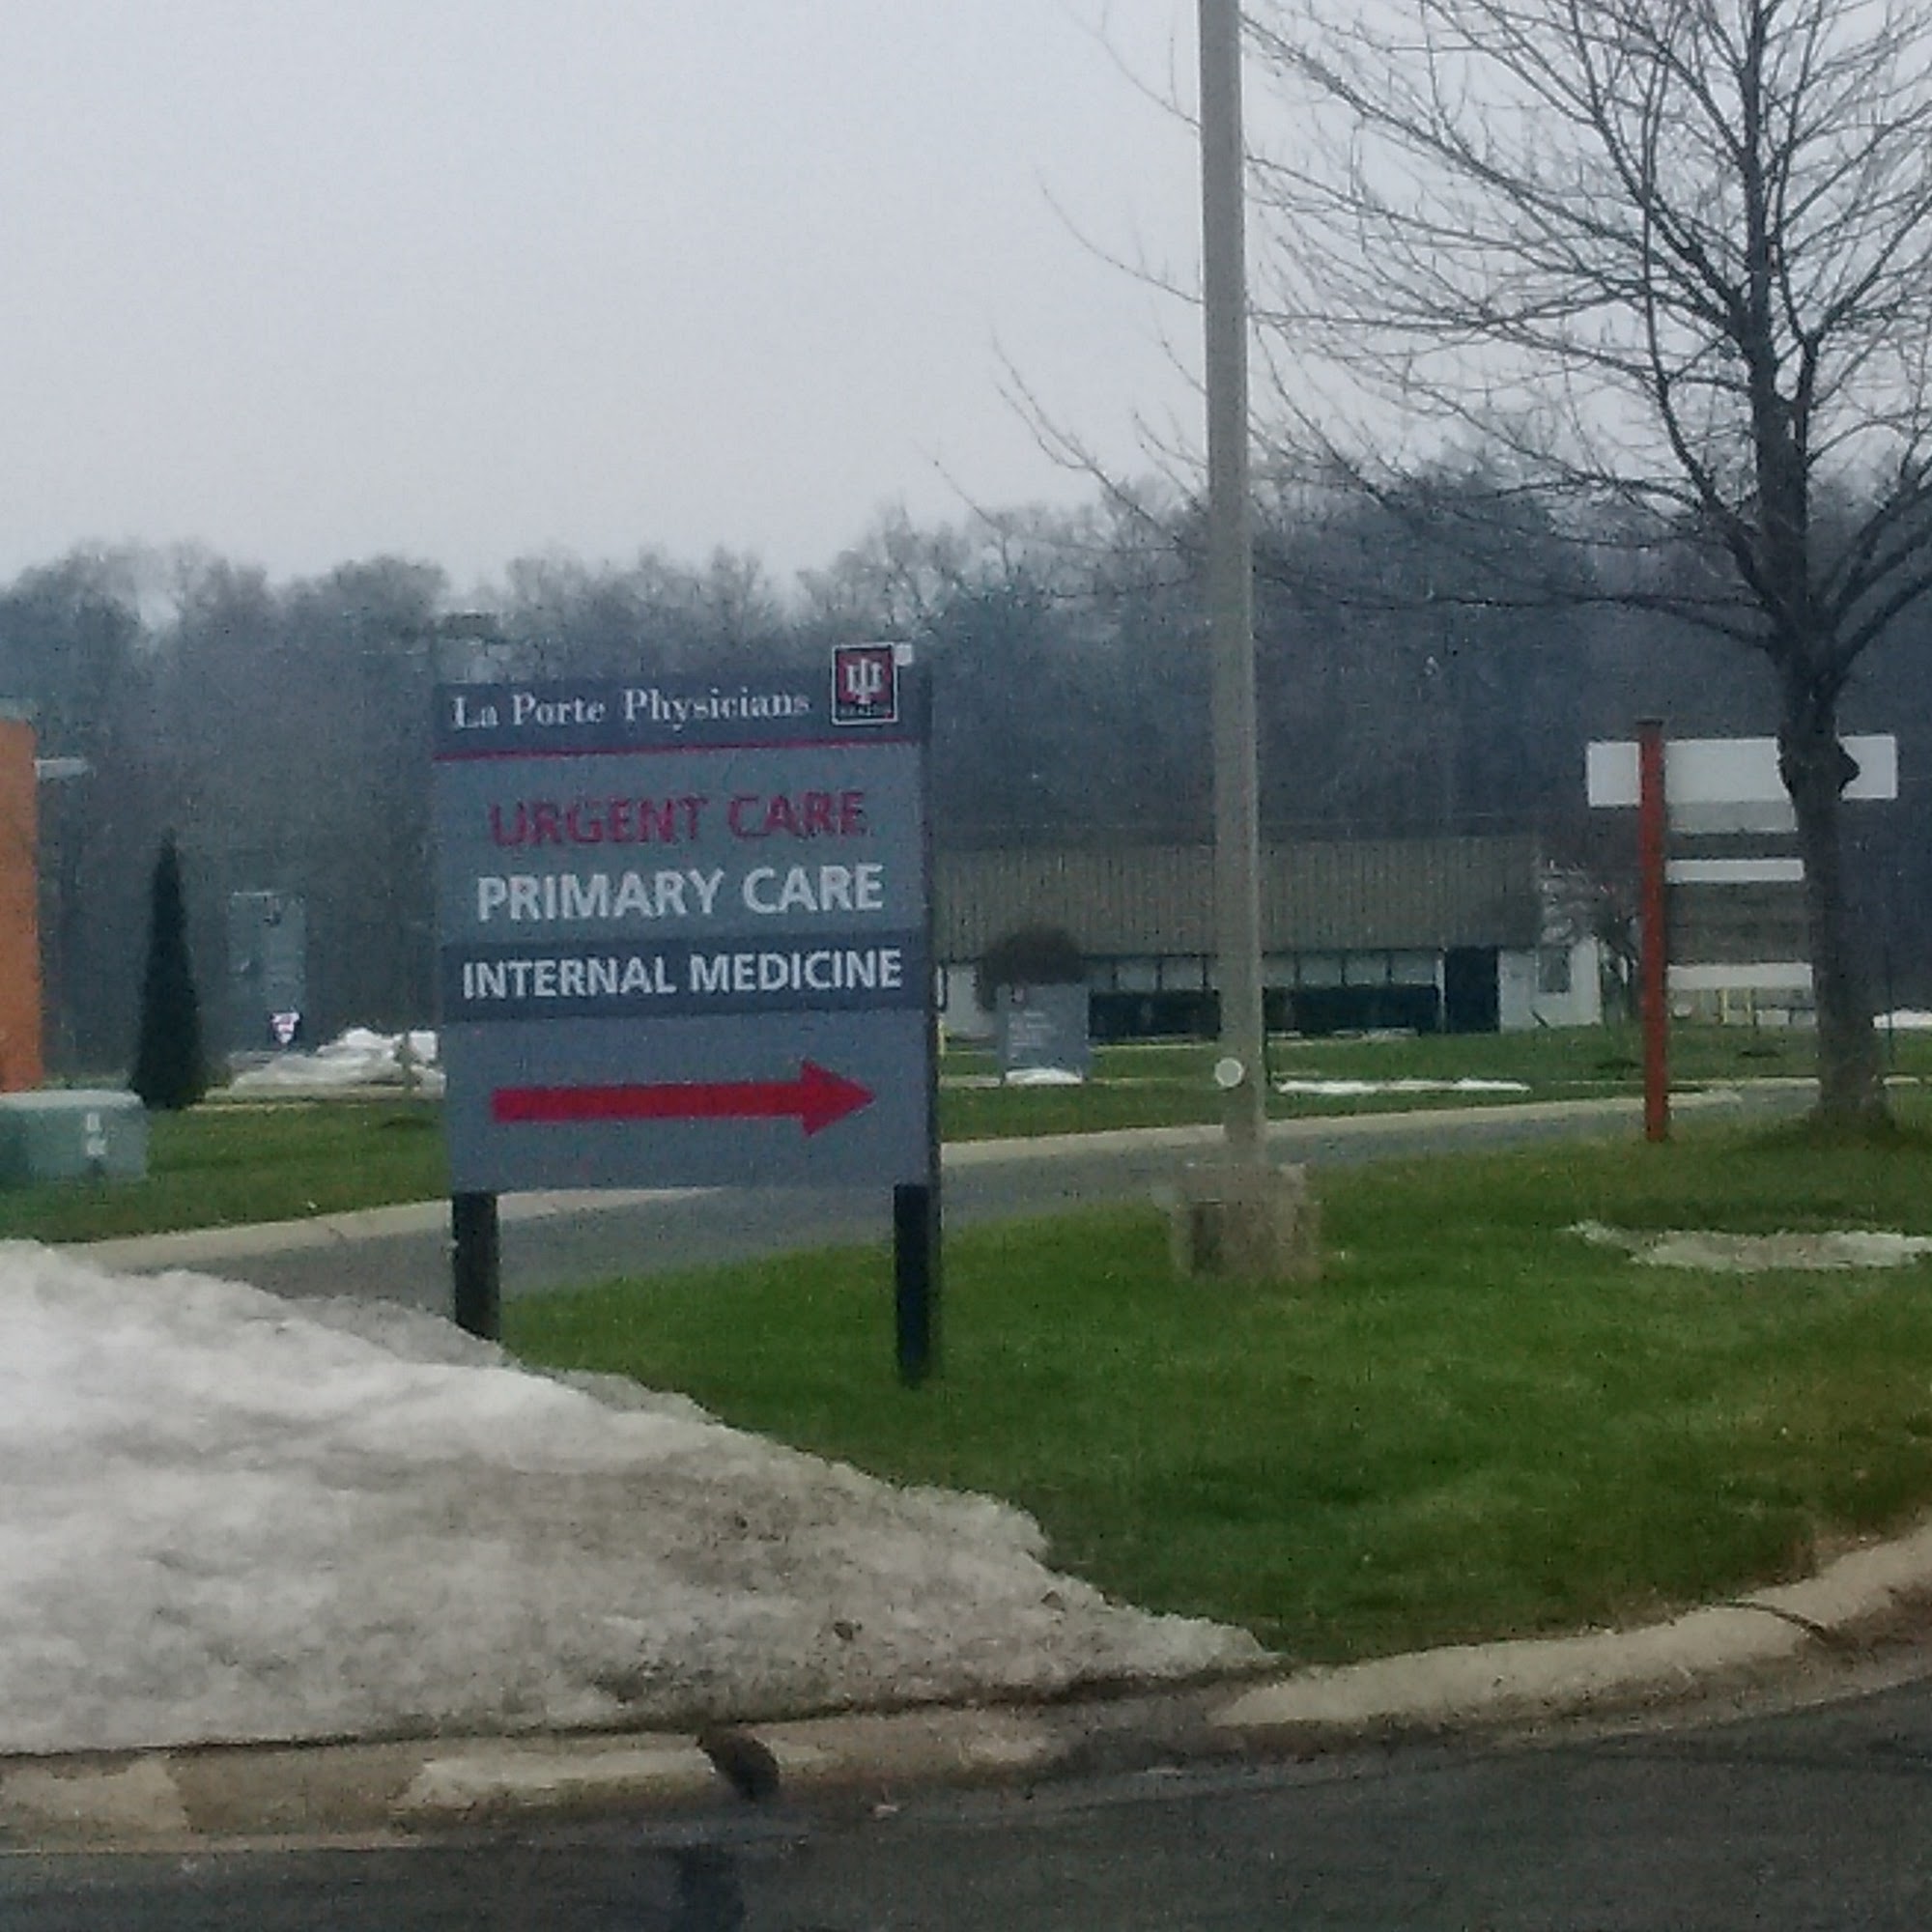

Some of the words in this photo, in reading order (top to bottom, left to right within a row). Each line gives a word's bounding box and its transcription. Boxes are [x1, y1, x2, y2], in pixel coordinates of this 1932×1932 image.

[452, 696, 497, 729] La
[512, 693, 607, 726] Porte
[623, 687, 810, 731] Physicians
[488, 797, 708, 846] URGENT
[727, 791, 869, 838] CARE
[477, 870, 724, 922] PRIMARY
[742, 864, 884, 915] CARE
[462, 957, 676, 1000] INTERNAL
[689, 950, 902, 993] MEDICINE
